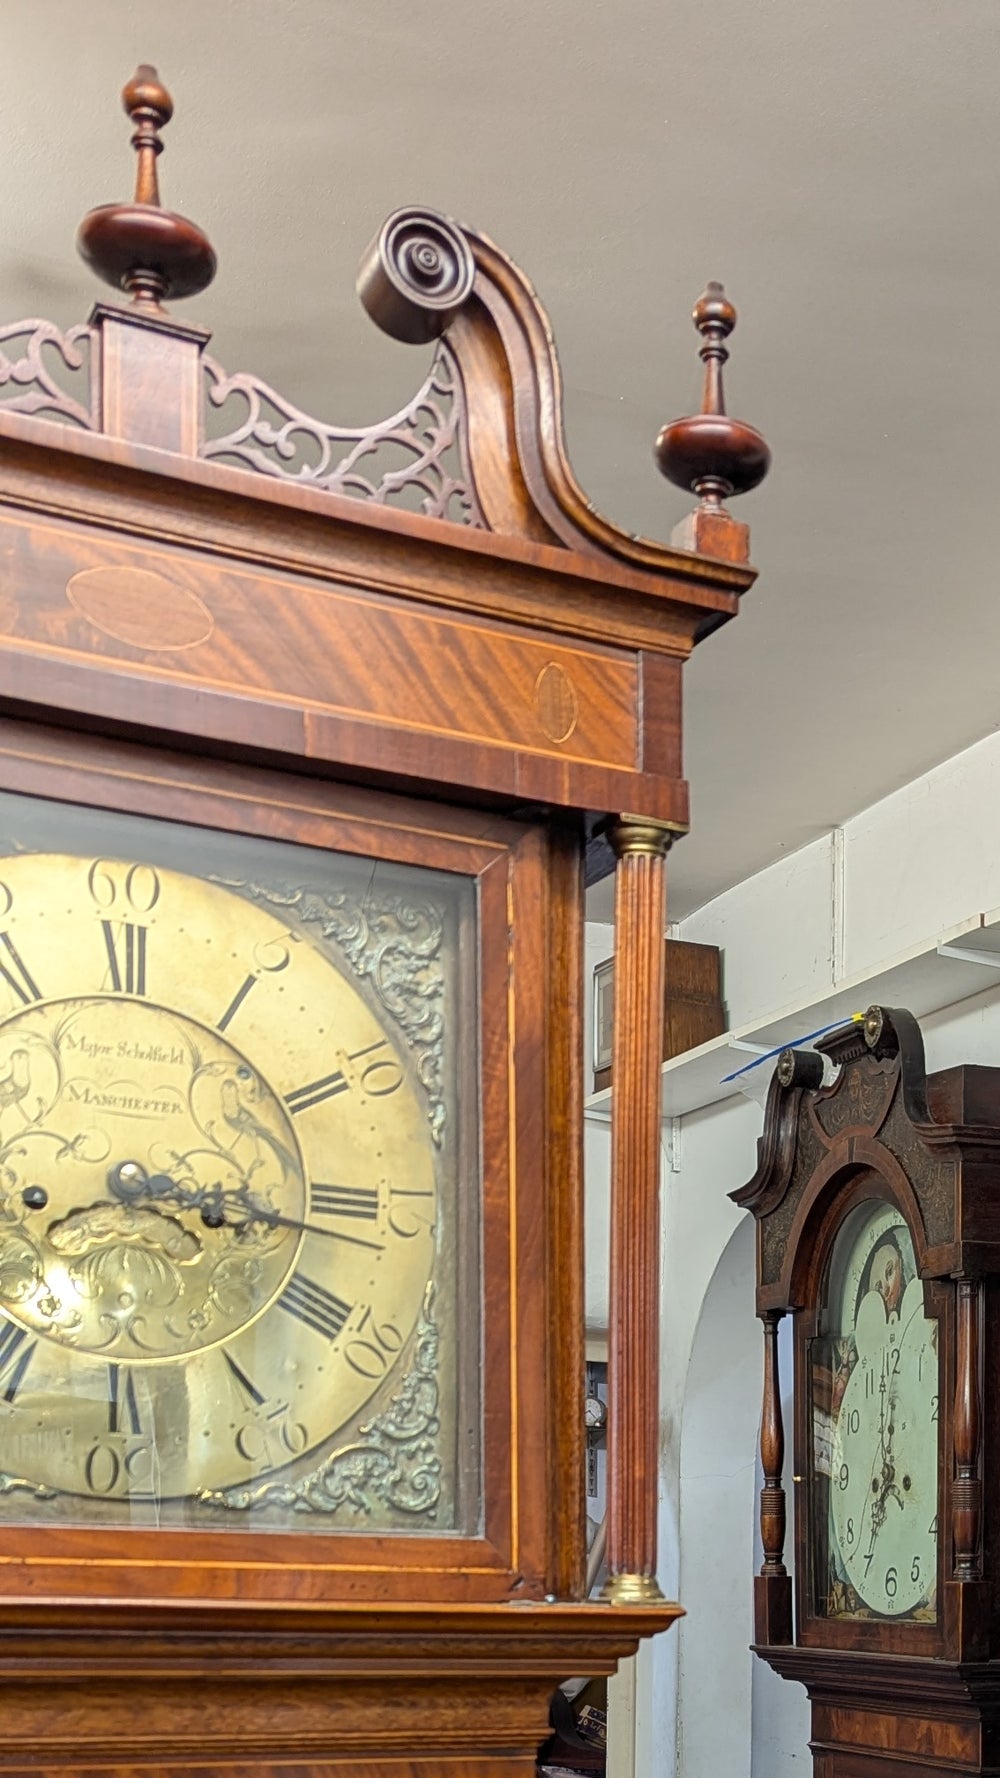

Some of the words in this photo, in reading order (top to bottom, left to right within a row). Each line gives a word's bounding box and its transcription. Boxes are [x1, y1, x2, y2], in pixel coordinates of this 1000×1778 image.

[88, 859, 159, 912] 60
[99, 920, 149, 996] XII
[253, 932, 303, 972] 5
[216, 970, 259, 1033] I
[67, 1034, 112, 1057] Major
[348, 1039, 404, 1096] 10
[283, 1069, 351, 1115] II
[311, 1183, 379, 1220] III
[387, 1182, 437, 1238] 15
[344, 1304, 404, 1379] 20
[886, 1348, 901, 1375] 12
[918, 1354, 923, 1382] 1
[108, 1363, 146, 1436] VI
[865, 1368, 875, 1399] 11
[235, 1402, 309, 1471] 25
[847, 1409, 860, 1436] 10
[85, 1443, 158, 1497] 30
[839, 1464, 849, 1491] 9
[846, 1518, 855, 1545] 8
[863, 1553, 874, 1578] 7
[885, 1567, 898, 1597] 6
[911, 1556, 921, 1583] 5
